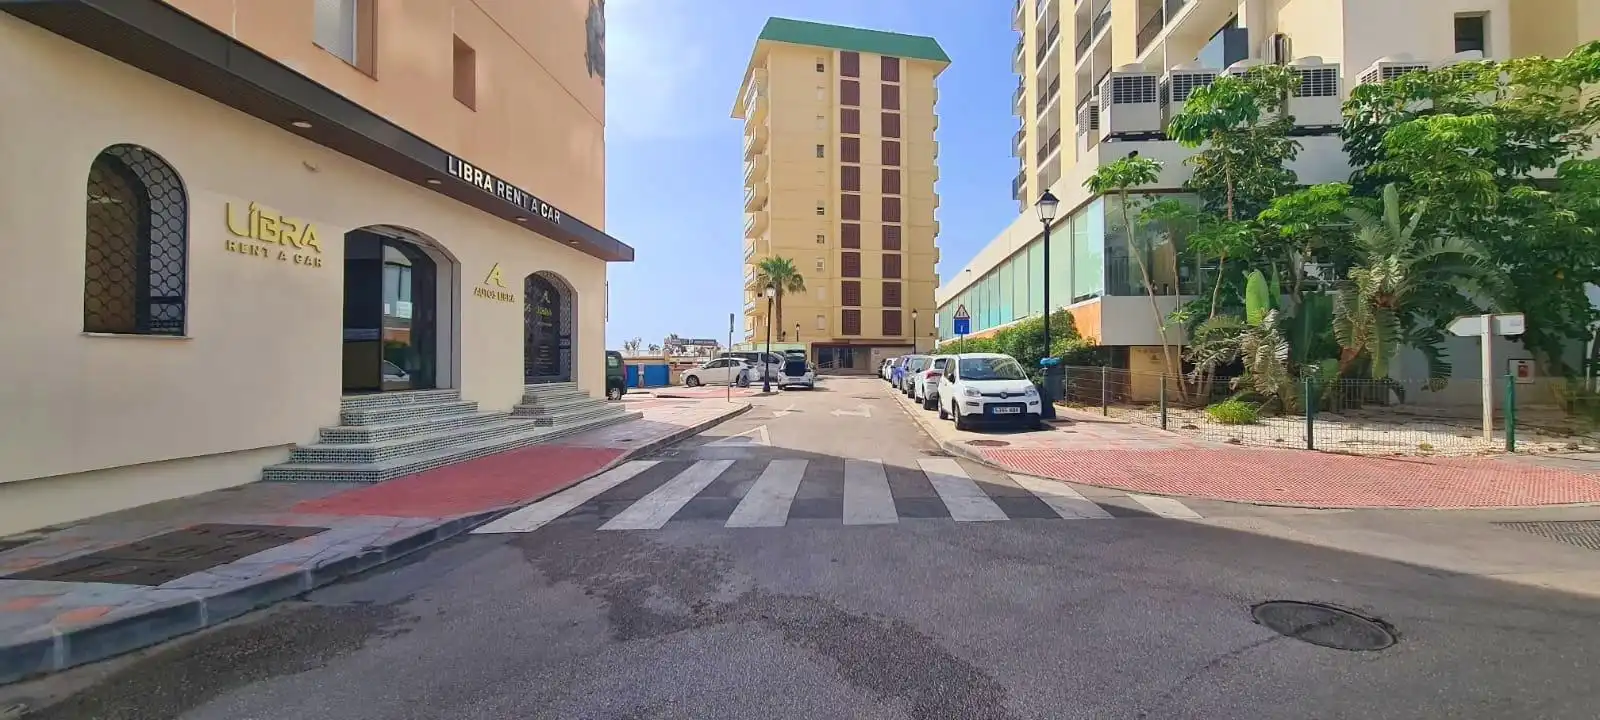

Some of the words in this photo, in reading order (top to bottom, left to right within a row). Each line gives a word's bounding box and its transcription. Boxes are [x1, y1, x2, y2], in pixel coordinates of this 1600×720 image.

[448, 155, 493, 193] LIBRA
[497, 180, 528, 208] RENT
[530, 199, 539, 214] A
[541, 203, 560, 225] CAR
[224, 239, 269, 258] RENT
[277, 250, 288, 262] A
[293, 252, 323, 269] CAR
[473, 286, 497, 300] AUTOS
